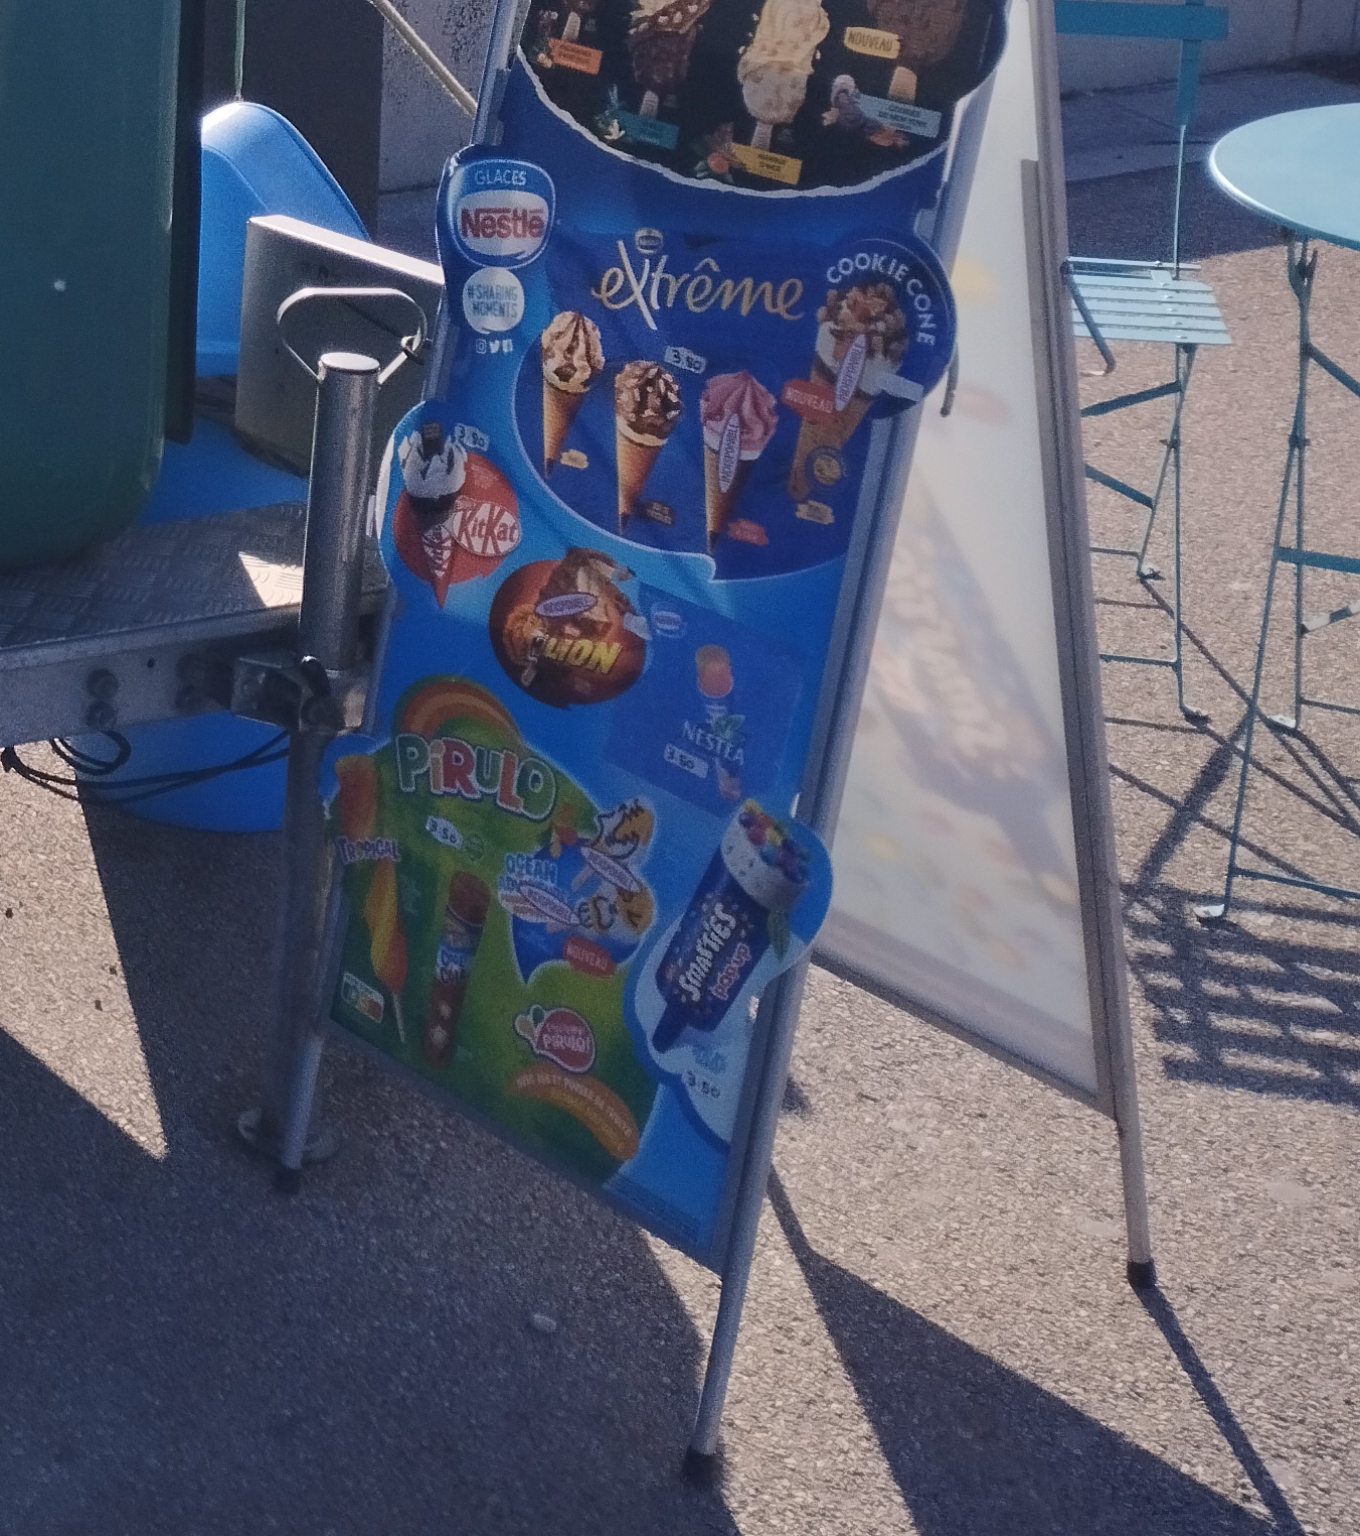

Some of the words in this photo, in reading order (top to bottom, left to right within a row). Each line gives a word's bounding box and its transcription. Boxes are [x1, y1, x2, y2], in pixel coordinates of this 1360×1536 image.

[846, 31, 893, 52] NOUVEAU
[474, 168, 528, 186] GLACES
[460, 206, 545, 240] Nestlé
[466, 283, 519, 302] #SHARING
[826, 253, 909, 285] COOKIE
[904, 275, 937, 348] CONE
[471, 300, 519, 319] MOMENTS
[784, 386, 834, 415] NOUVEAU
[457, 500, 520, 556] KitKat
[543, 637, 624, 675] LION
[681, 719, 745, 766] NESTEA
[336, 836, 401, 864] TROPICAL
[505, 853, 558, 886] OCEAN
[566, 943, 609, 971] NOUVEAU
